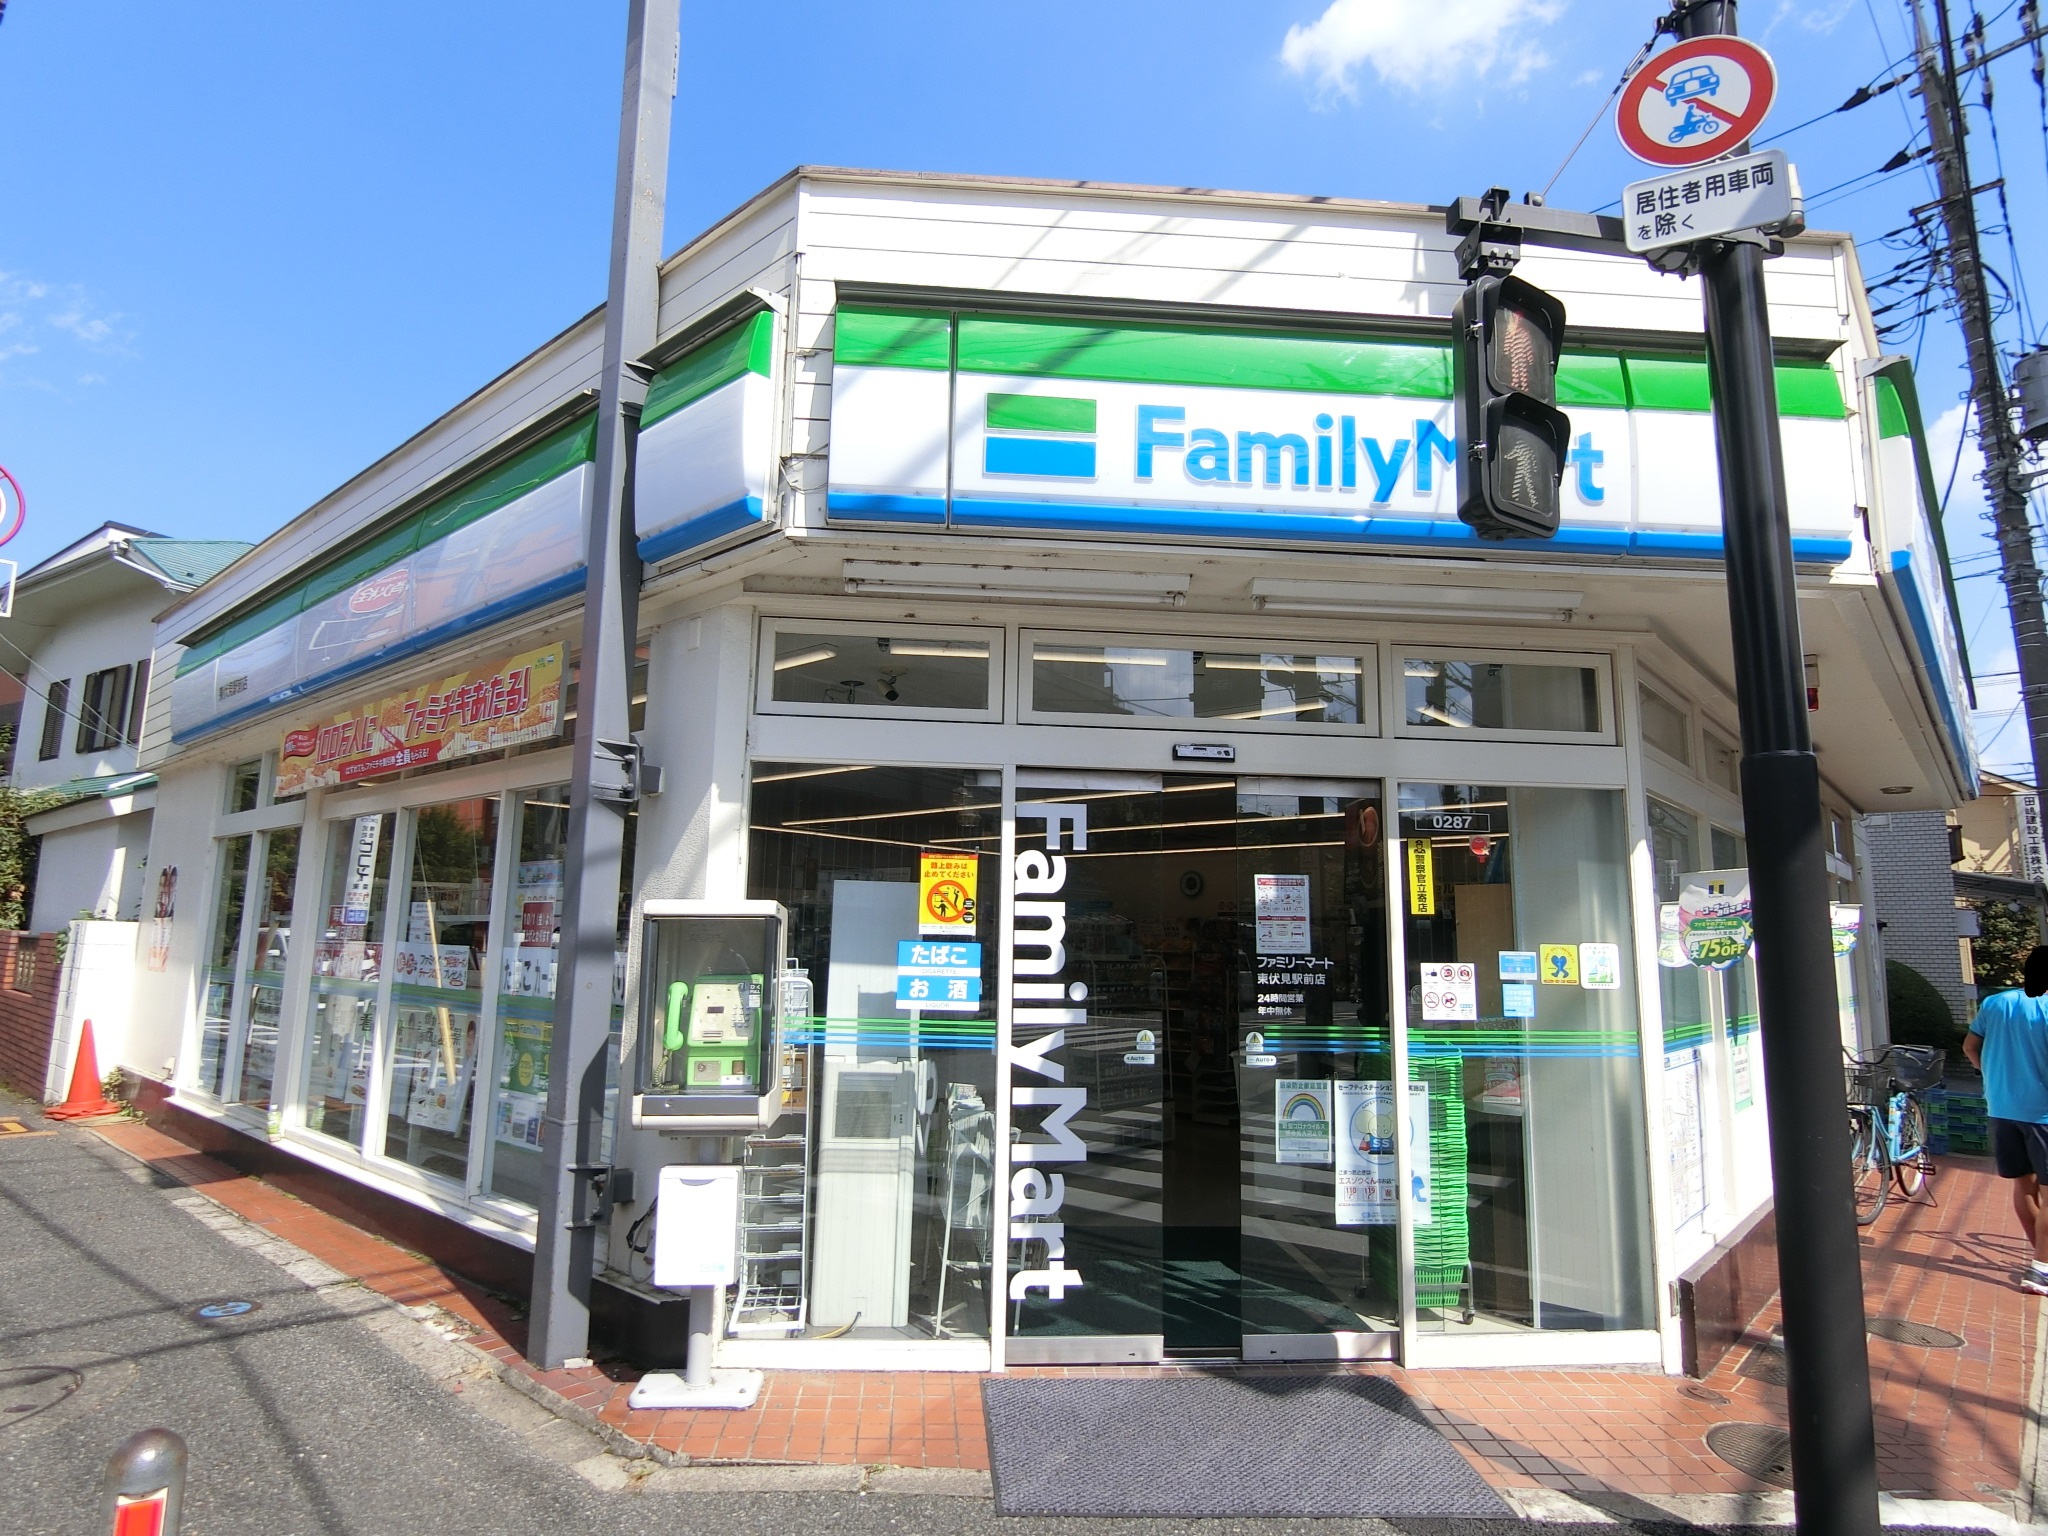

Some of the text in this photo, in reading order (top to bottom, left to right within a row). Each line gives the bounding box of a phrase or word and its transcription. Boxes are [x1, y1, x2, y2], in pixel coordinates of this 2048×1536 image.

[1636, 162, 1774, 216] 居住者用車両
[1638, 213, 1695, 241] を除く
[1134, 404, 1605, 505] FamilyMt
[1432, 815, 1473, 830] 0287
[924, 870, 975, 878] 止めてください
[1415, 854, 1429, 913] 警察官立寄店
[911, 945, 968, 965] たばこ
[1256, 956, 1335, 969] ファミリーマート
[1257, 972, 1326, 986] 東伏見駅前店
[1257, 993, 1305, 1004] 24時間営業
[1257, 1005, 1293, 1016] 年中無休
[1009, 803, 1088, 1301] FamilyMart
[1372, 1139, 1390, 1147] SS
